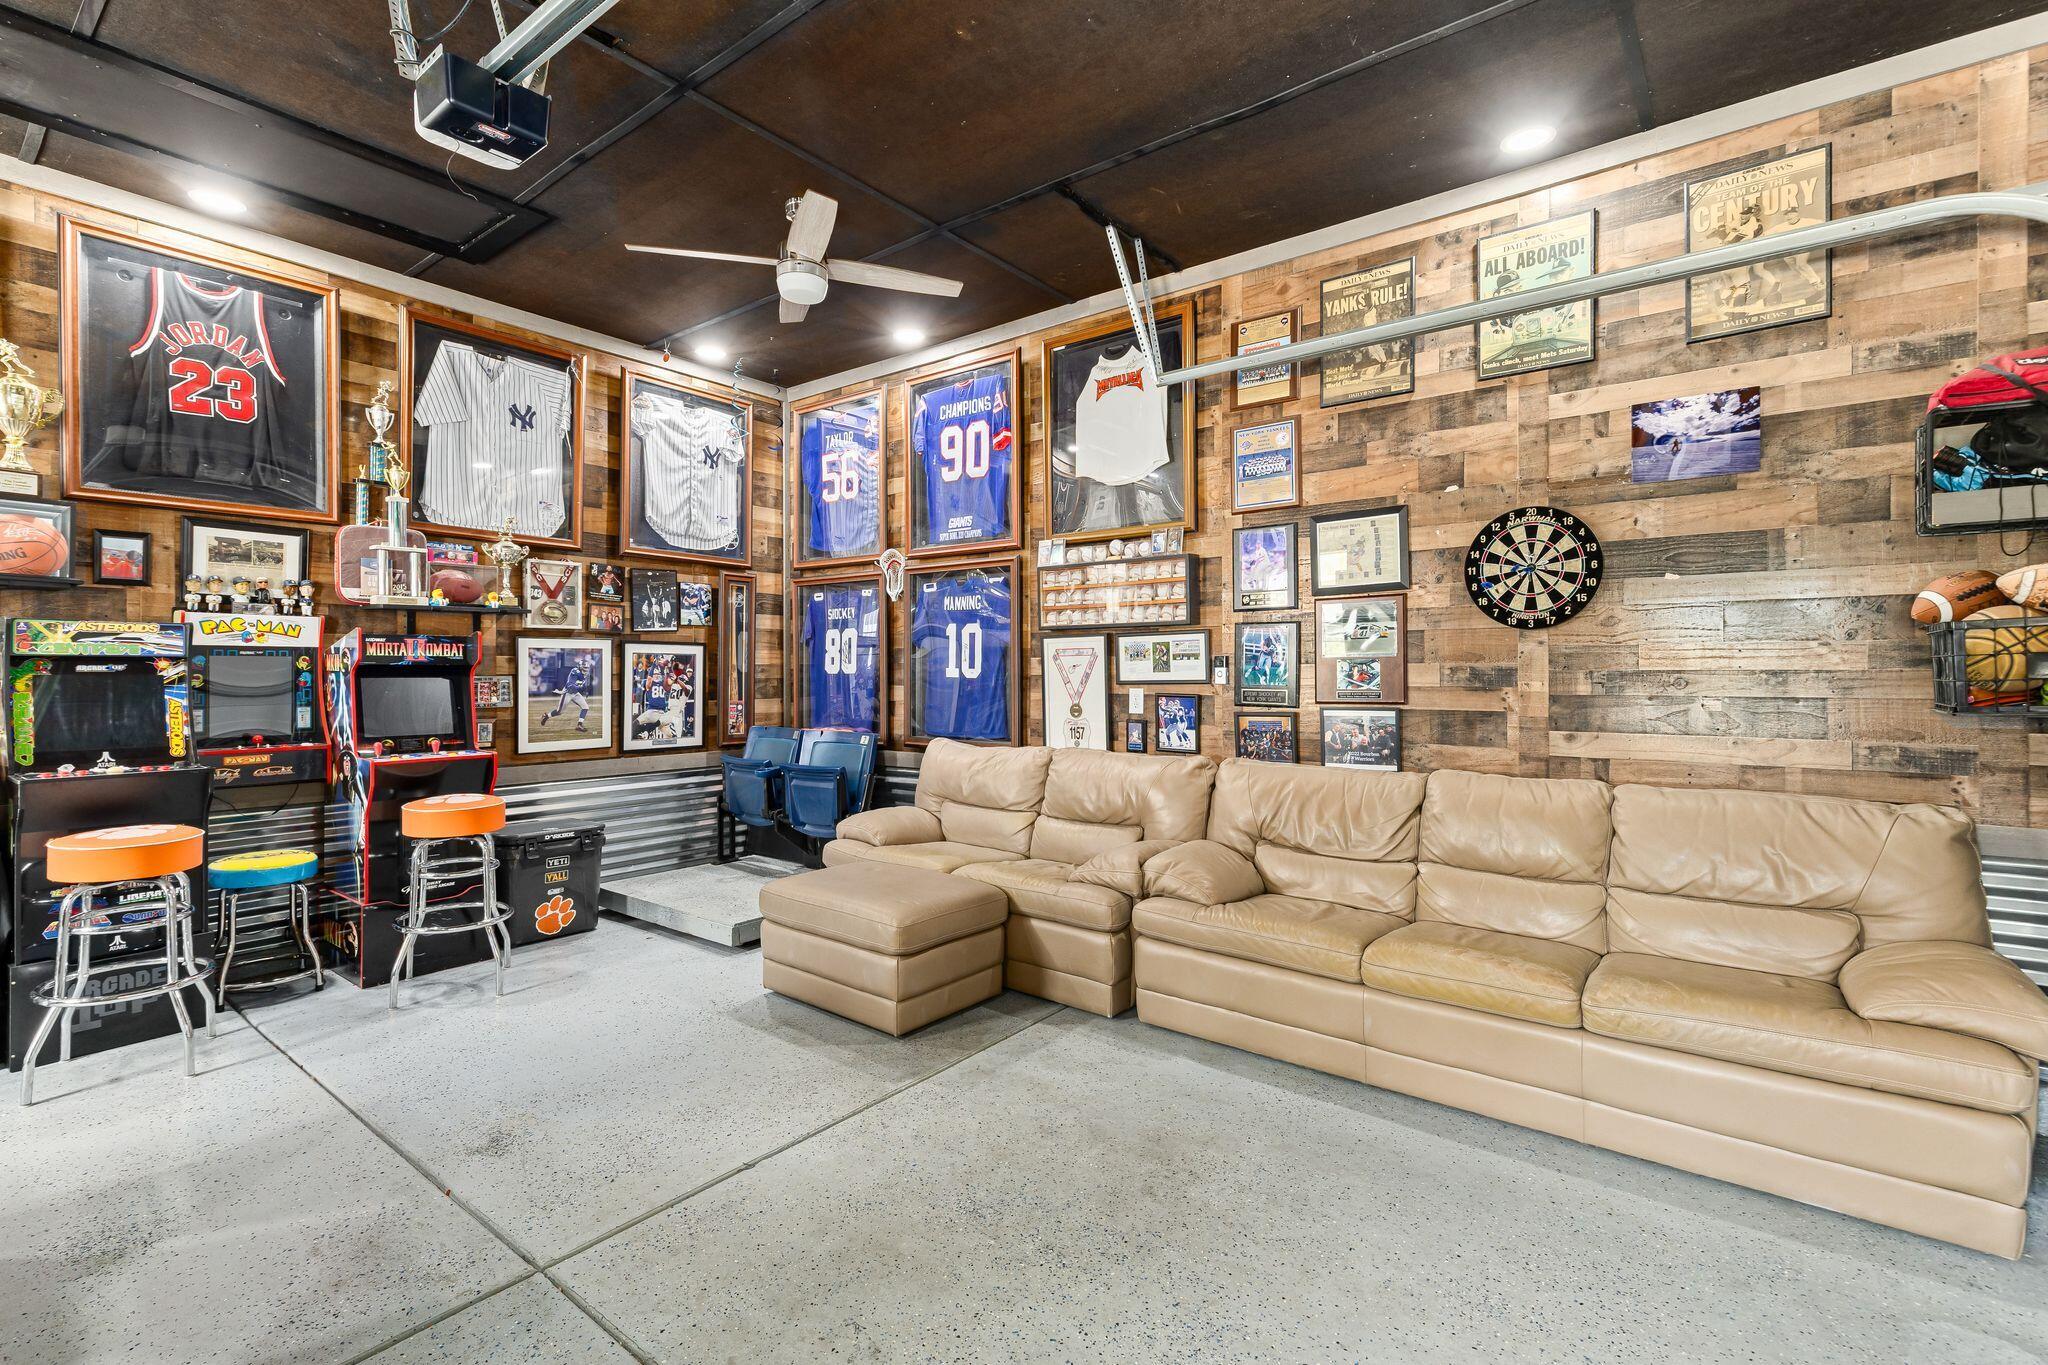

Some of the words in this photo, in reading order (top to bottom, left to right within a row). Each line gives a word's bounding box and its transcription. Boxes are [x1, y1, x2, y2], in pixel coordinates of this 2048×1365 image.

[1714, 175, 1748, 189] DAILY
[1759, 163, 1794, 176] NEWS
[1718, 189, 1747, 202] TEAM
[1751, 183, 1768, 193] OF
[1770, 175, 1792, 188] THE
[1692, 176, 1818, 233] CENTURY
[1484, 256, 1510, 277] ALL
[1516, 237, 1585, 270] ABOARD!
[1369, 269, 1391, 278] NEWS
[1371, 282, 1408, 307] RULE!
[1722, 317, 1750, 328] DAILY
[1760, 311, 1787, 321] NEWS
[159, 320, 265, 369] JORDAN
[1558, 345, 1588, 355] Saturday
[168, 357, 257, 424] 23
[939, 395, 992, 421] CHAMPIONS
[825, 431, 854, 450] TAYLOR
[939, 419, 991, 483] 90
[821, 450, 860, 503] 56
[1509, 512, 1515, 521] 5
[1526, 507, 1537, 516] 20
[948, 516, 973, 528] GIANTS
[1506, 515, 1561, 528] NARWHAL
[1562, 516, 1574, 525] 18
[1491, 522, 1500, 531] 12
[1579, 527, 1586, 536] 4
[1480, 535, 1486, 543] 9
[1585, 543, 1597, 551] 13
[1470, 550, 1480, 559] 14
[1591, 560, 1598, 569] 6
[1467, 567, 1476, 575] 11
[1471, 582, 1478, 591] 8
[1585, 578, 1597, 587] 10
[944, 595, 982, 611] MANNING
[1478, 597, 1488, 606] 16
[1576, 593, 1588, 602] 15
[827, 607, 856, 620] SHOCKEY
[1492, 608, 1499, 617] 7
[1511, 612, 1550, 620] KINGSTON
[1564, 606, 1572, 615] 2
[1507, 617, 1517, 625] 19
[1528, 620, 1534, 628] 3
[1546, 616, 1556, 625] 17
[74, 621, 160, 633] ASTEROIDS
[199, 617, 302, 639] PAC-MAN
[366, 642, 415, 656] MORTAL
[416, 642, 465, 657] KOMBAT
[824, 628, 858, 675] 80
[945, 622, 983, 679] 10
[652, 685, 665, 698] 80
[670, 689, 683, 699] 20
[168, 698, 186, 758] ASTEROIDS
[1069, 726, 1085, 740] 1157
[548, 857, 568, 866] YETI
